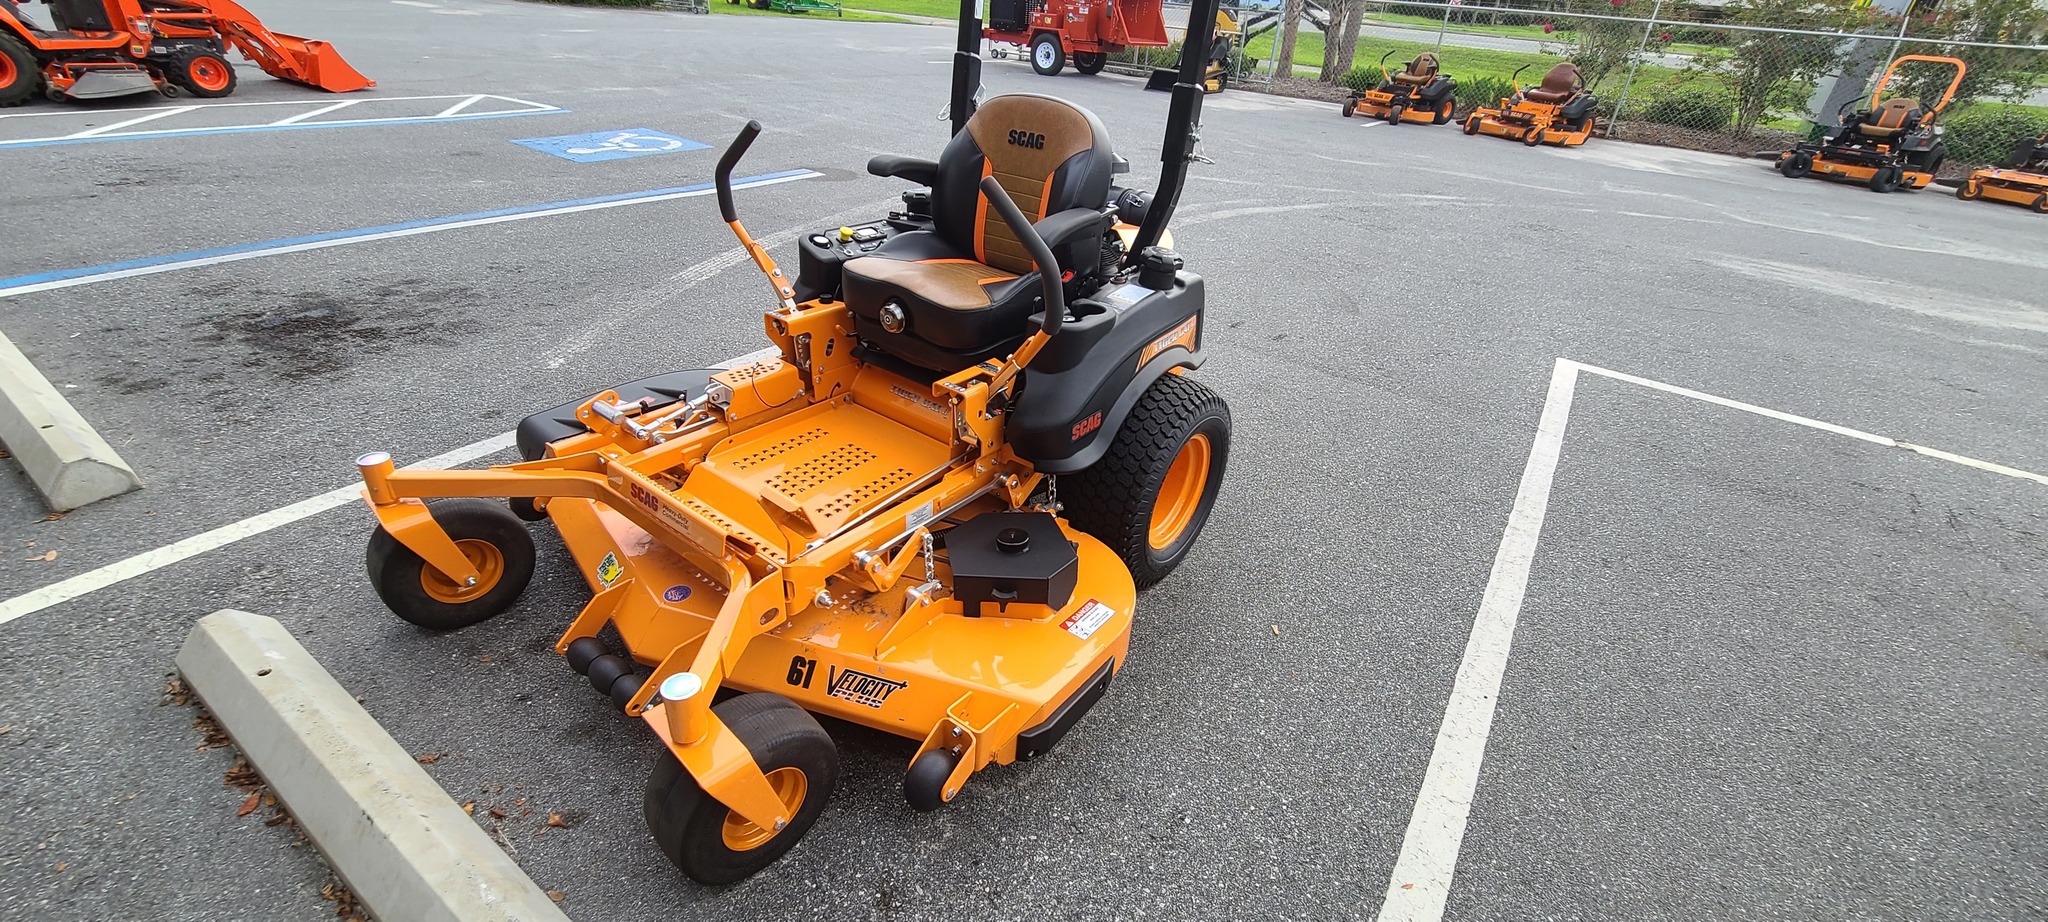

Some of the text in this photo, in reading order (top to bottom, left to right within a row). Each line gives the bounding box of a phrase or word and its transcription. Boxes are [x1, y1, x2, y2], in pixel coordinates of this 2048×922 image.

[1008, 129, 1045, 150] SCAG
[1153, 331, 1179, 352] TIGER
[890, 384, 920, 404] TIGER
[1071, 411, 1102, 441] SCAG
[631, 482, 658, 512] SCAG
[662, 503, 689, 525] Heavy-Duty
[662, 510, 690, 531] Commercial
[1070, 601, 1097, 621] DANGER
[786, 655, 817, 689] 61
[832, 689, 883, 708] PLUS
